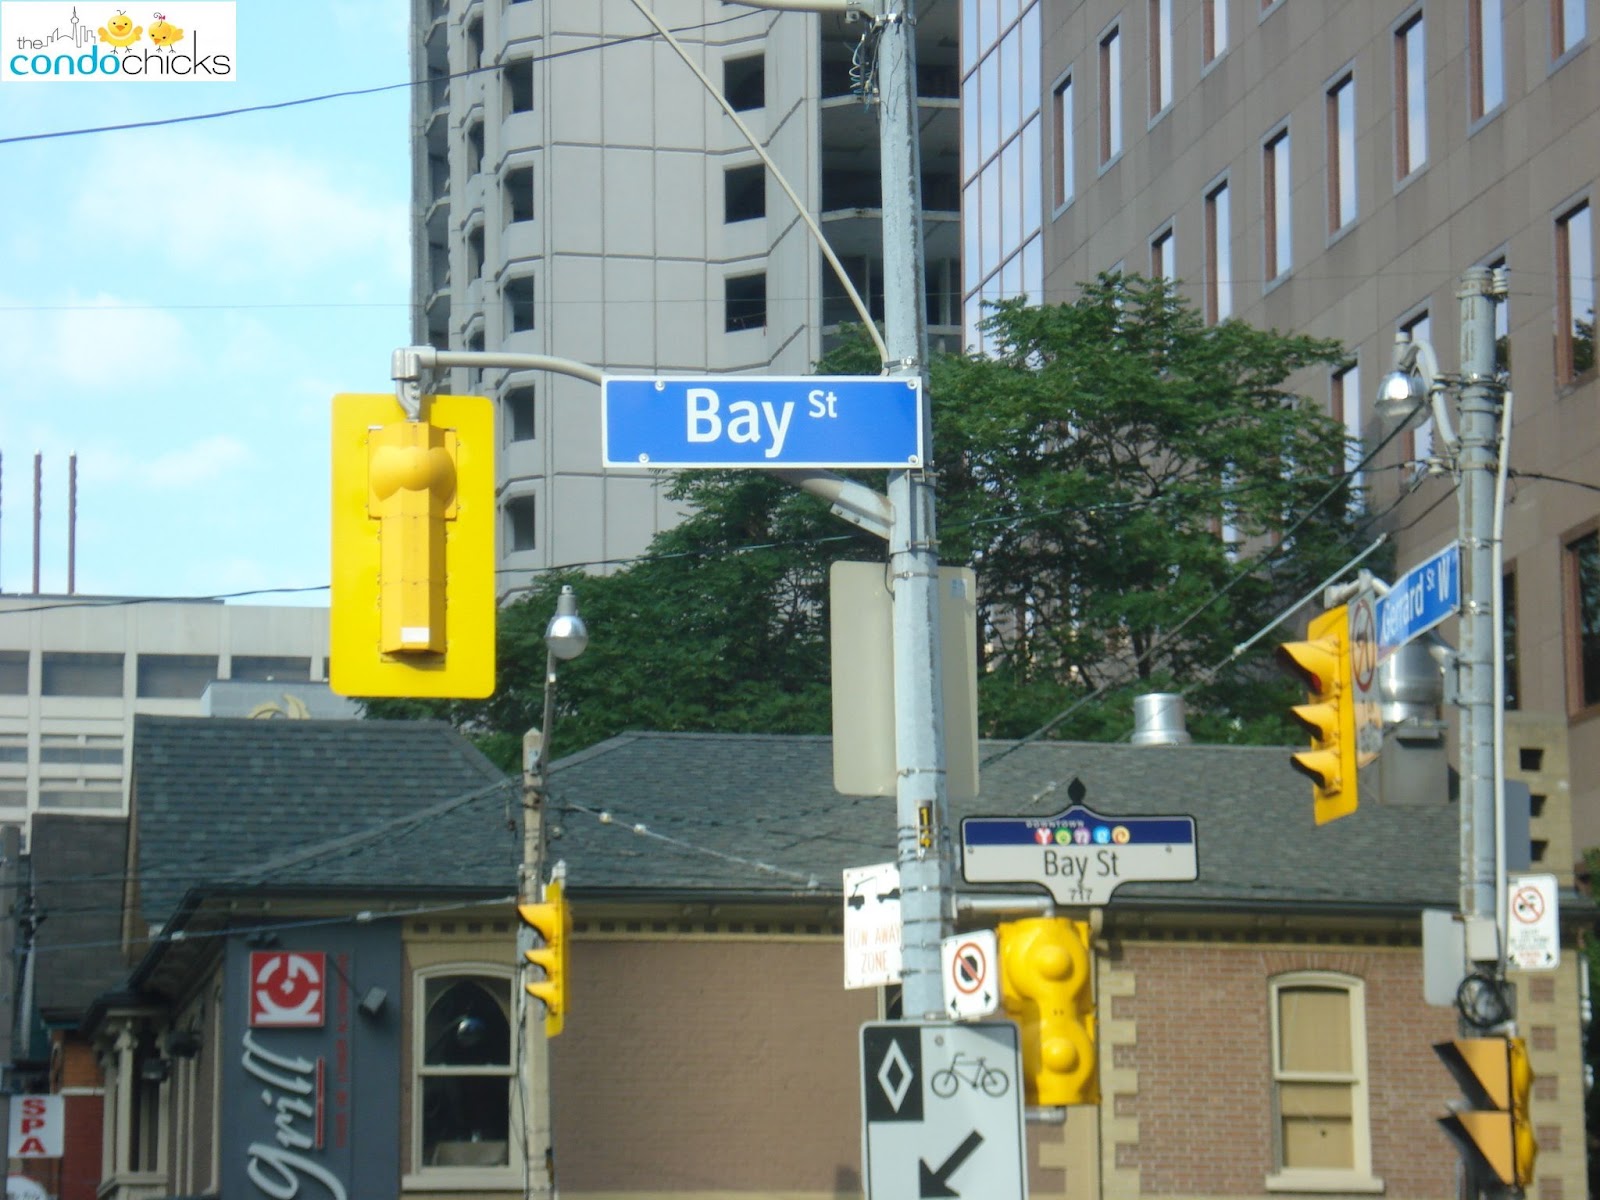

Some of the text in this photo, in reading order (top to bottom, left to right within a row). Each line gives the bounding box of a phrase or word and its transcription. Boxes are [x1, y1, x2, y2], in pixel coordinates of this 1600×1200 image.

[686, 387, 838, 458] Bay St
[1437, 554, 1451, 603] W
[1044, 849, 1119, 887] Bay St
[19, 1098, 46, 1154] SPA
